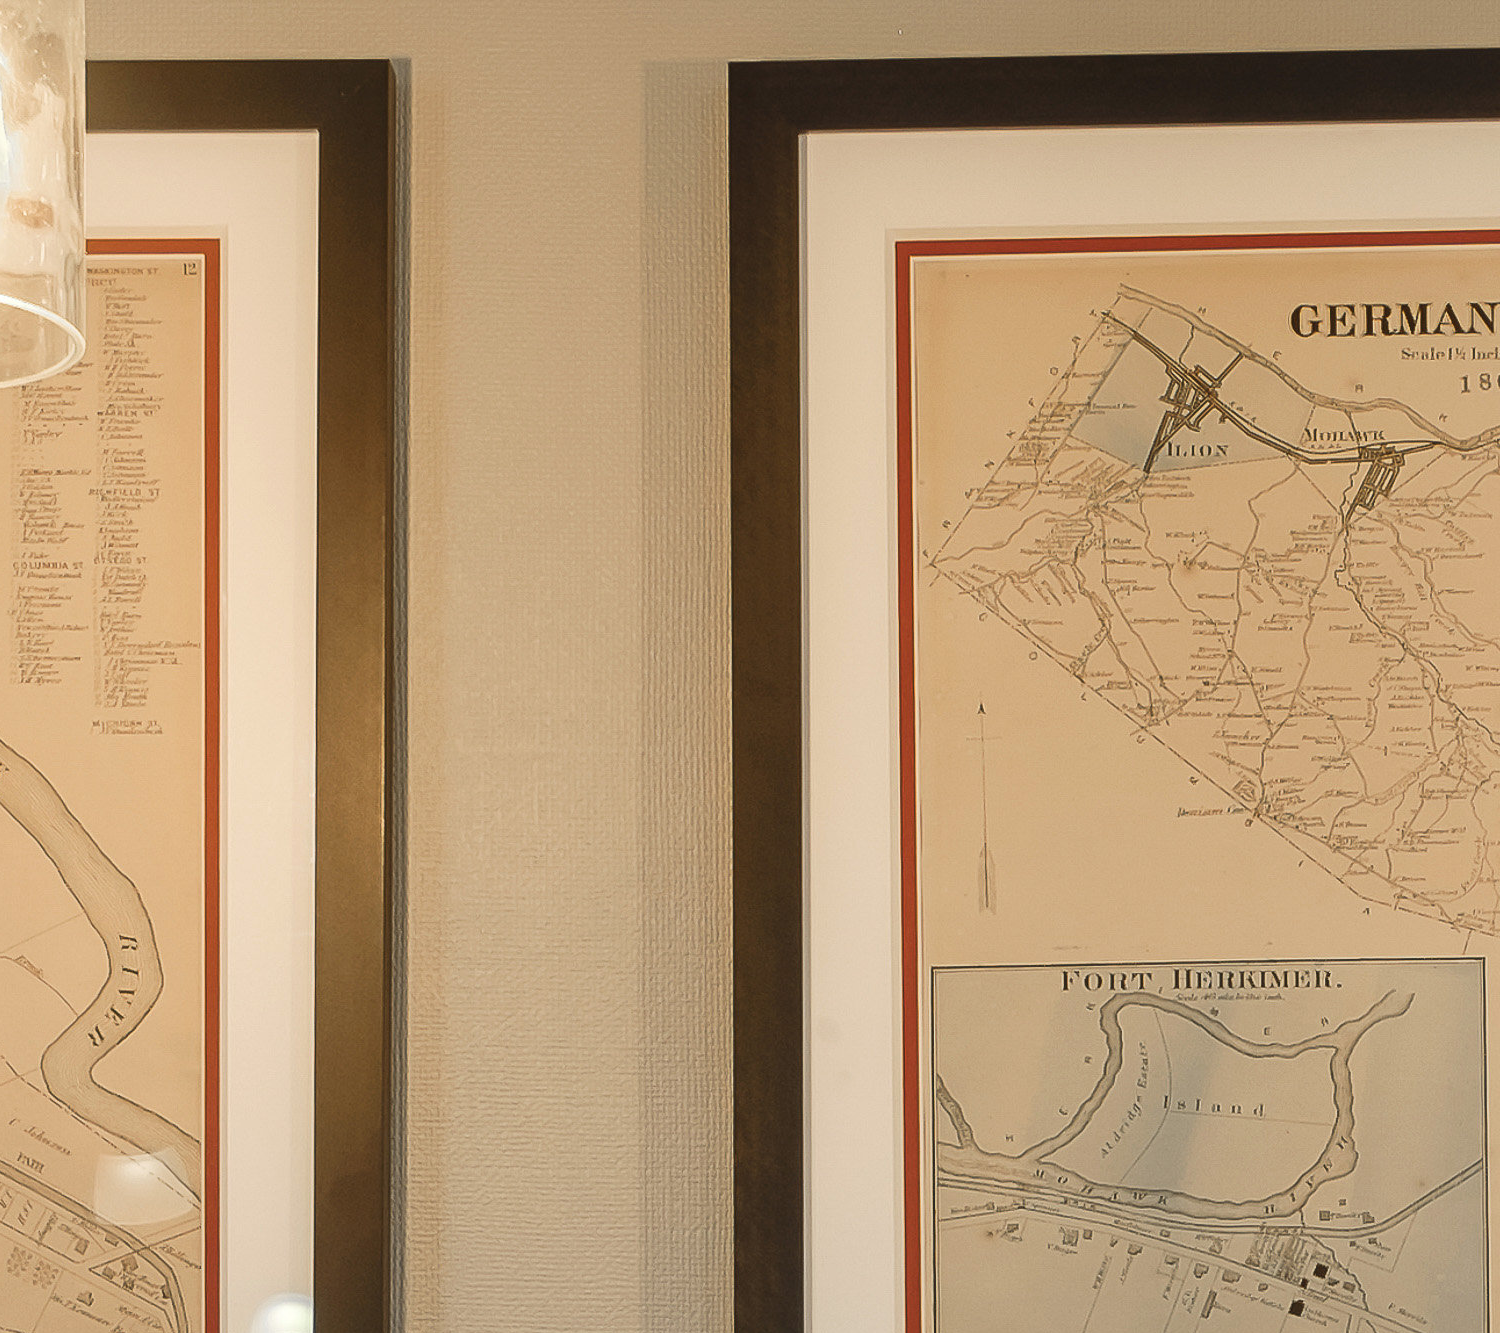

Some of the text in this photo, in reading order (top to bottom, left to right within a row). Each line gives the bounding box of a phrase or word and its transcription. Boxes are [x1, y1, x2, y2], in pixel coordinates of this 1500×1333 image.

[182, 263, 198, 276] 12
[1288, 302, 1500, 338] GERMAN
[1165, 442, 1230, 459] ILION
[1060, 969, 1154, 993] FORT
